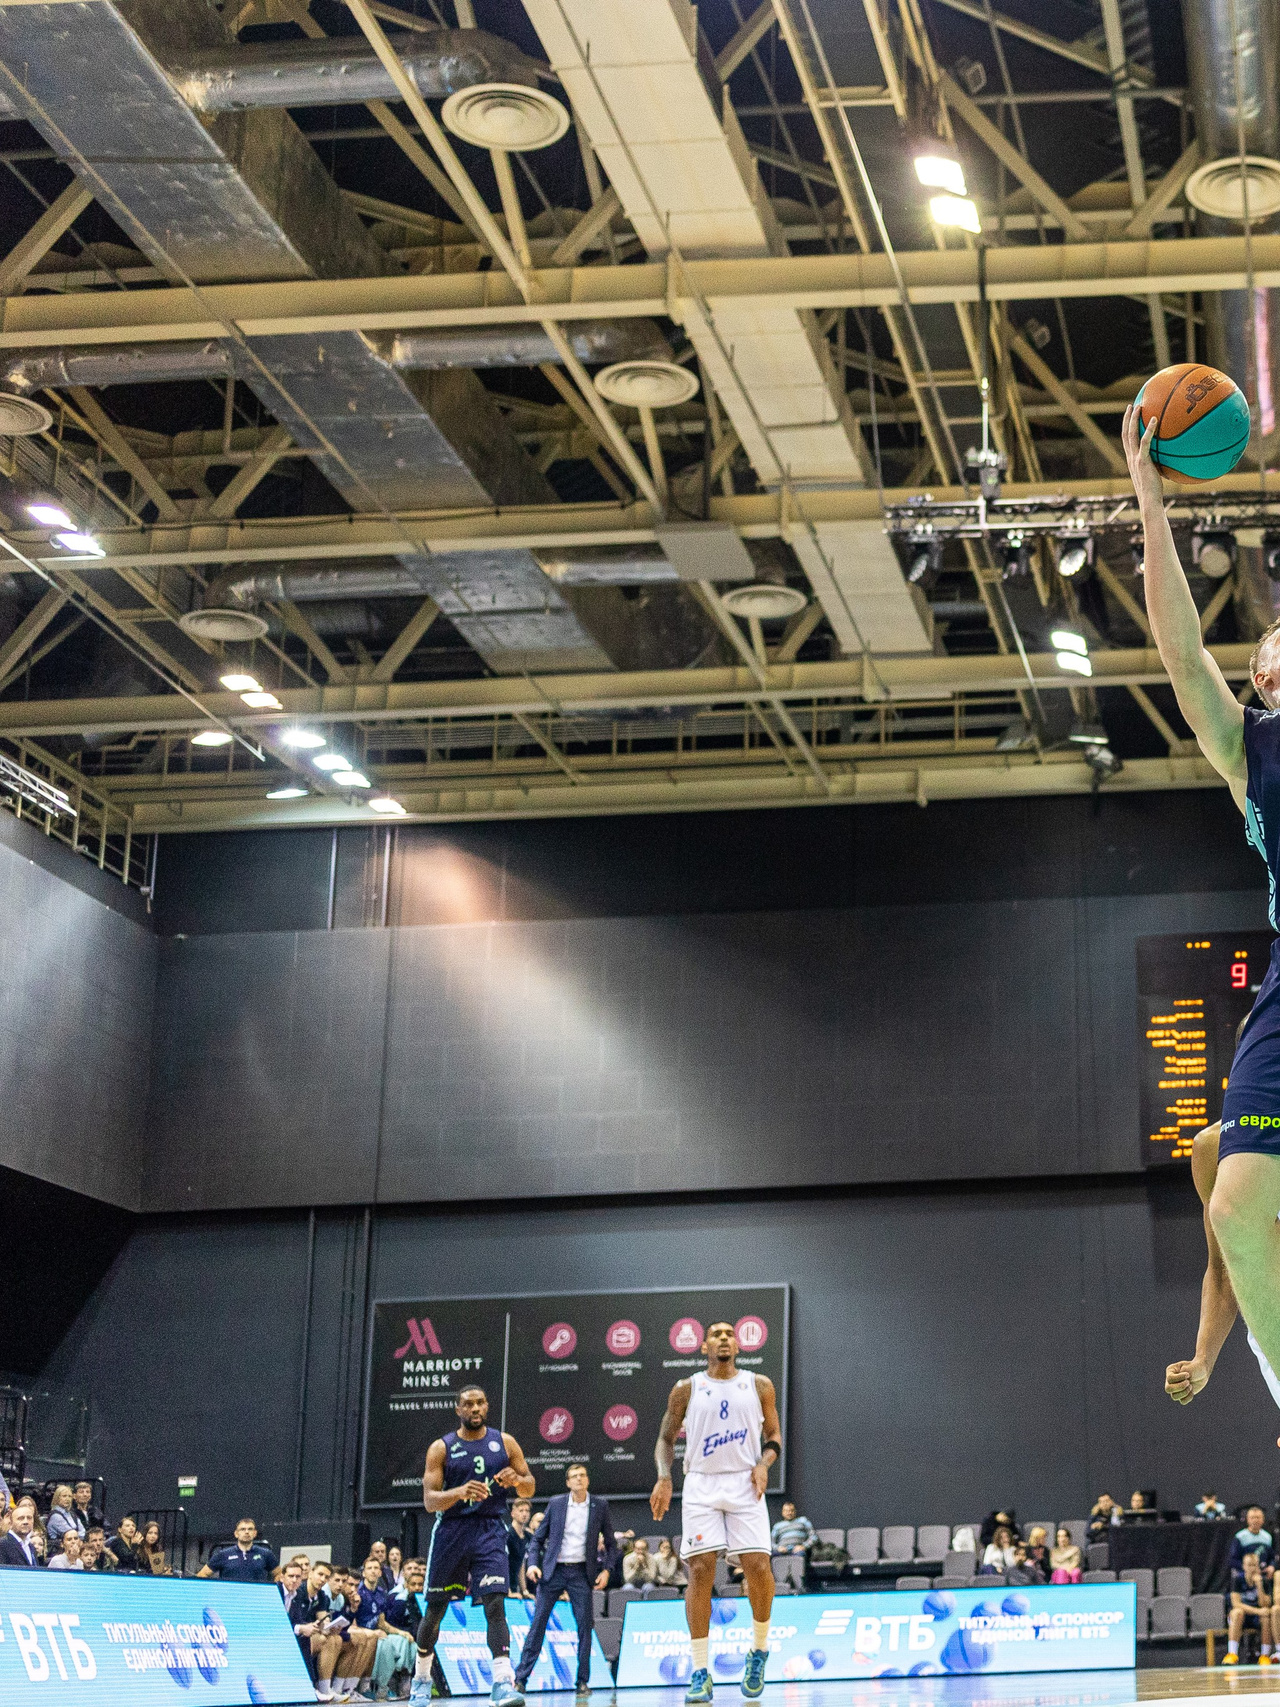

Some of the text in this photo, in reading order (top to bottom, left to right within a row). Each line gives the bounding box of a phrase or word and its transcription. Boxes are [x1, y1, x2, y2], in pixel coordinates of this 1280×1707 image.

[1231, 963, 1247, 987] 9
[403, 1357, 484, 1373] MARRIOTT
[402, 1374, 450, 1388] MINSK
[719, 1400, 729, 1420] 8
[609, 1415, 633, 1430] VIP
[703, 1427, 748, 1458] Enisey
[473, 1456, 485, 1474] 3
[958, 1611, 1125, 1630] ТИТУЛЬНЫЙ СПОНСОР
[102, 1619, 229, 1644] ТИТУЛЬНЫЙ СПОНСОР
[632, 1625, 798, 1645] ТИТУЛЬЙ СПОСОР
[854, 1615, 935, 1652] ВТБ
[1081, 1625, 1110, 1639] ВТБ
[9, 1612, 97, 1682] ВТБ
[123, 1646, 229, 1673] ЕДИНОЙ ЛИГИ ВТБ
